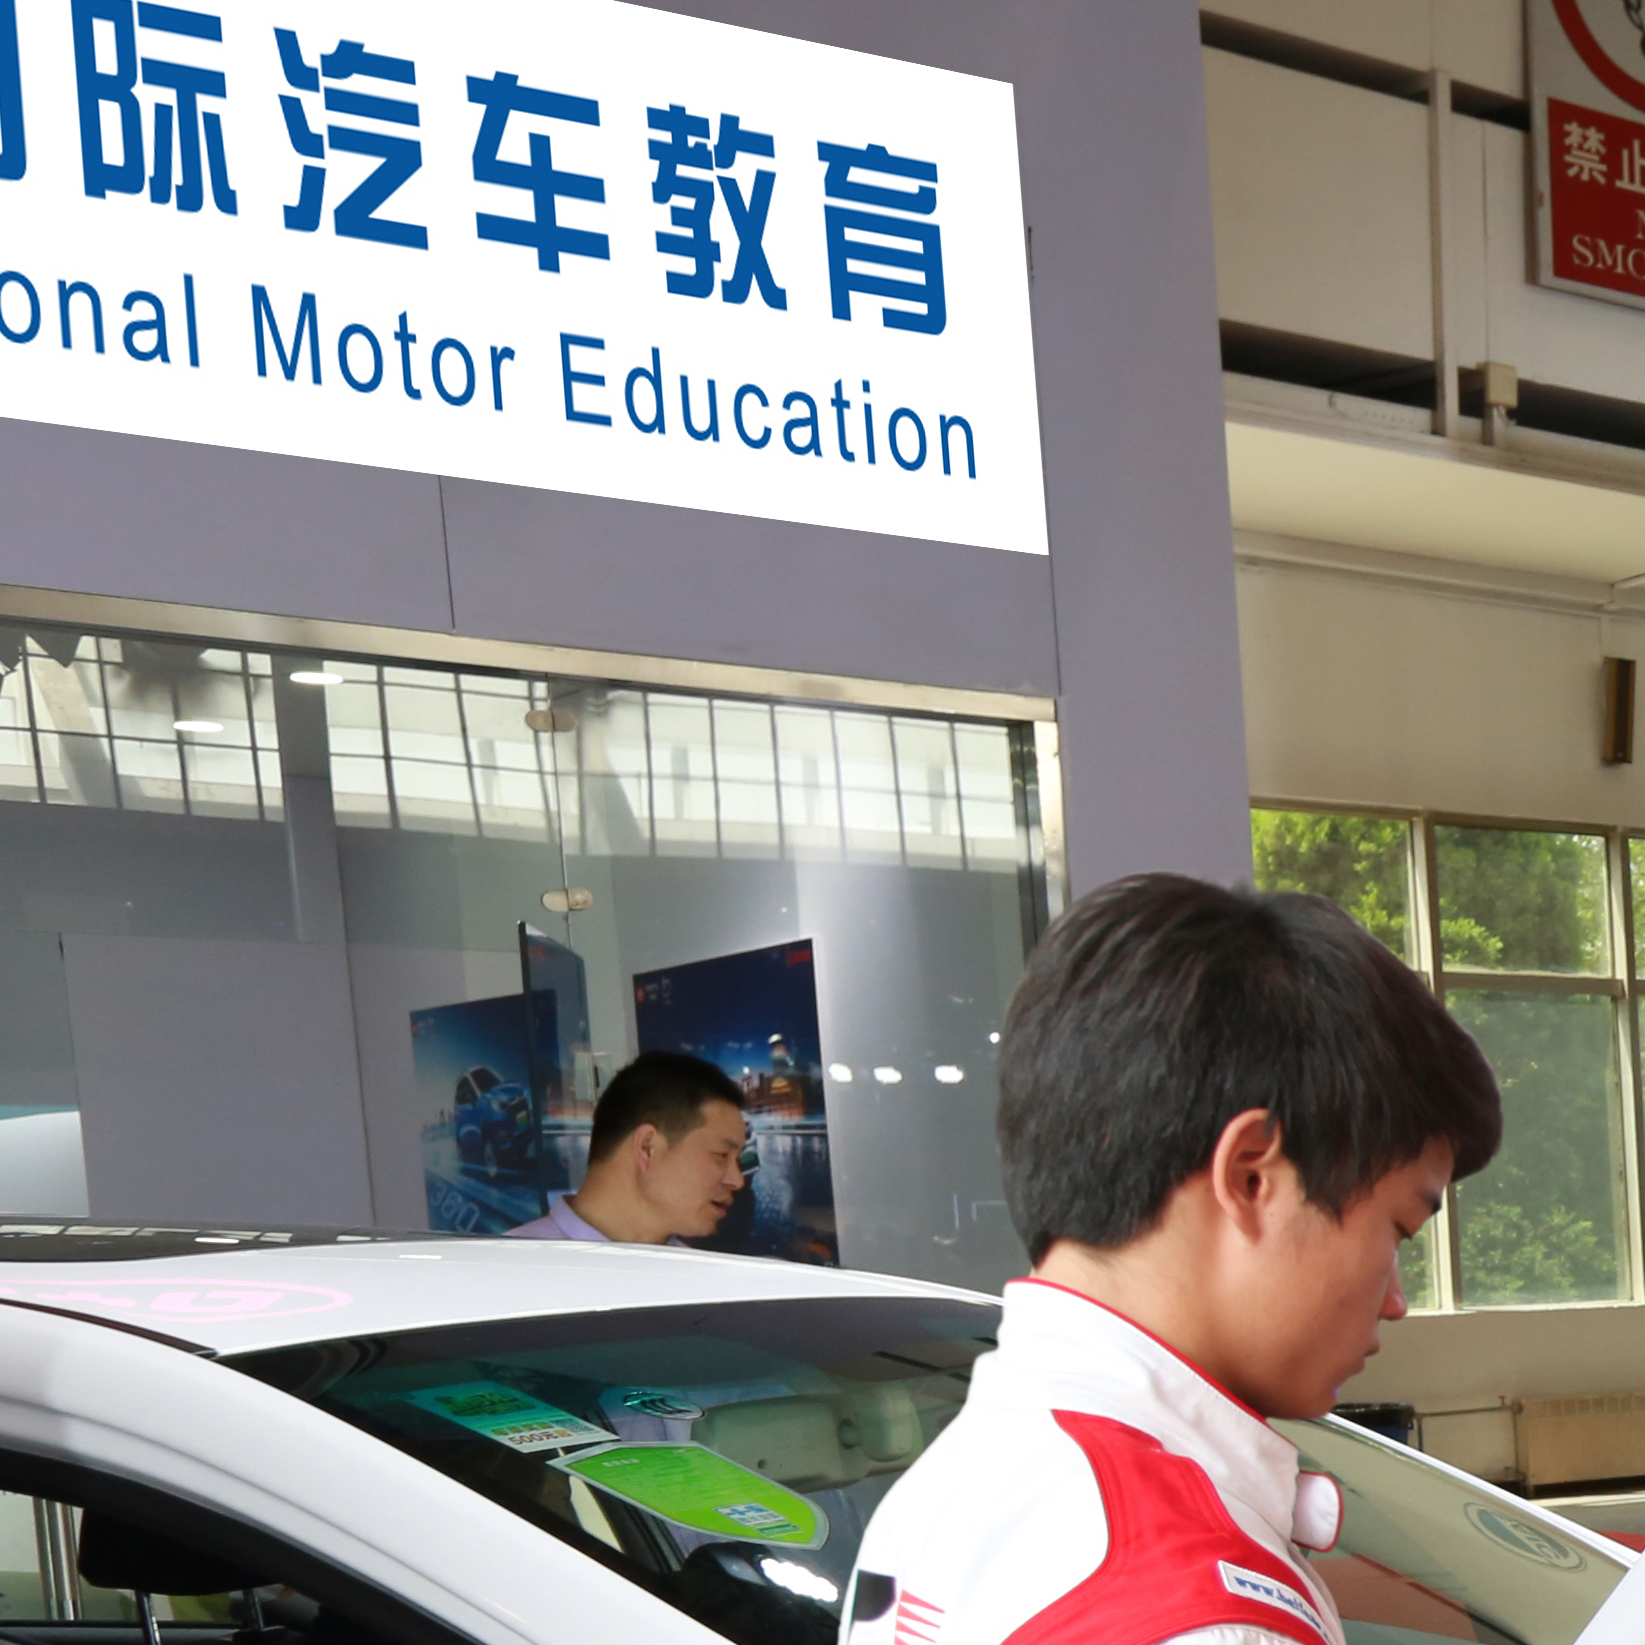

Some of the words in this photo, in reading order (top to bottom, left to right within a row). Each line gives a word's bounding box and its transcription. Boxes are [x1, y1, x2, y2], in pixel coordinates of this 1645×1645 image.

[0, 0, 948, 336] 际汽车教育
[250, 285, 515, 411] Motor
[558, 333, 977, 479] Education
